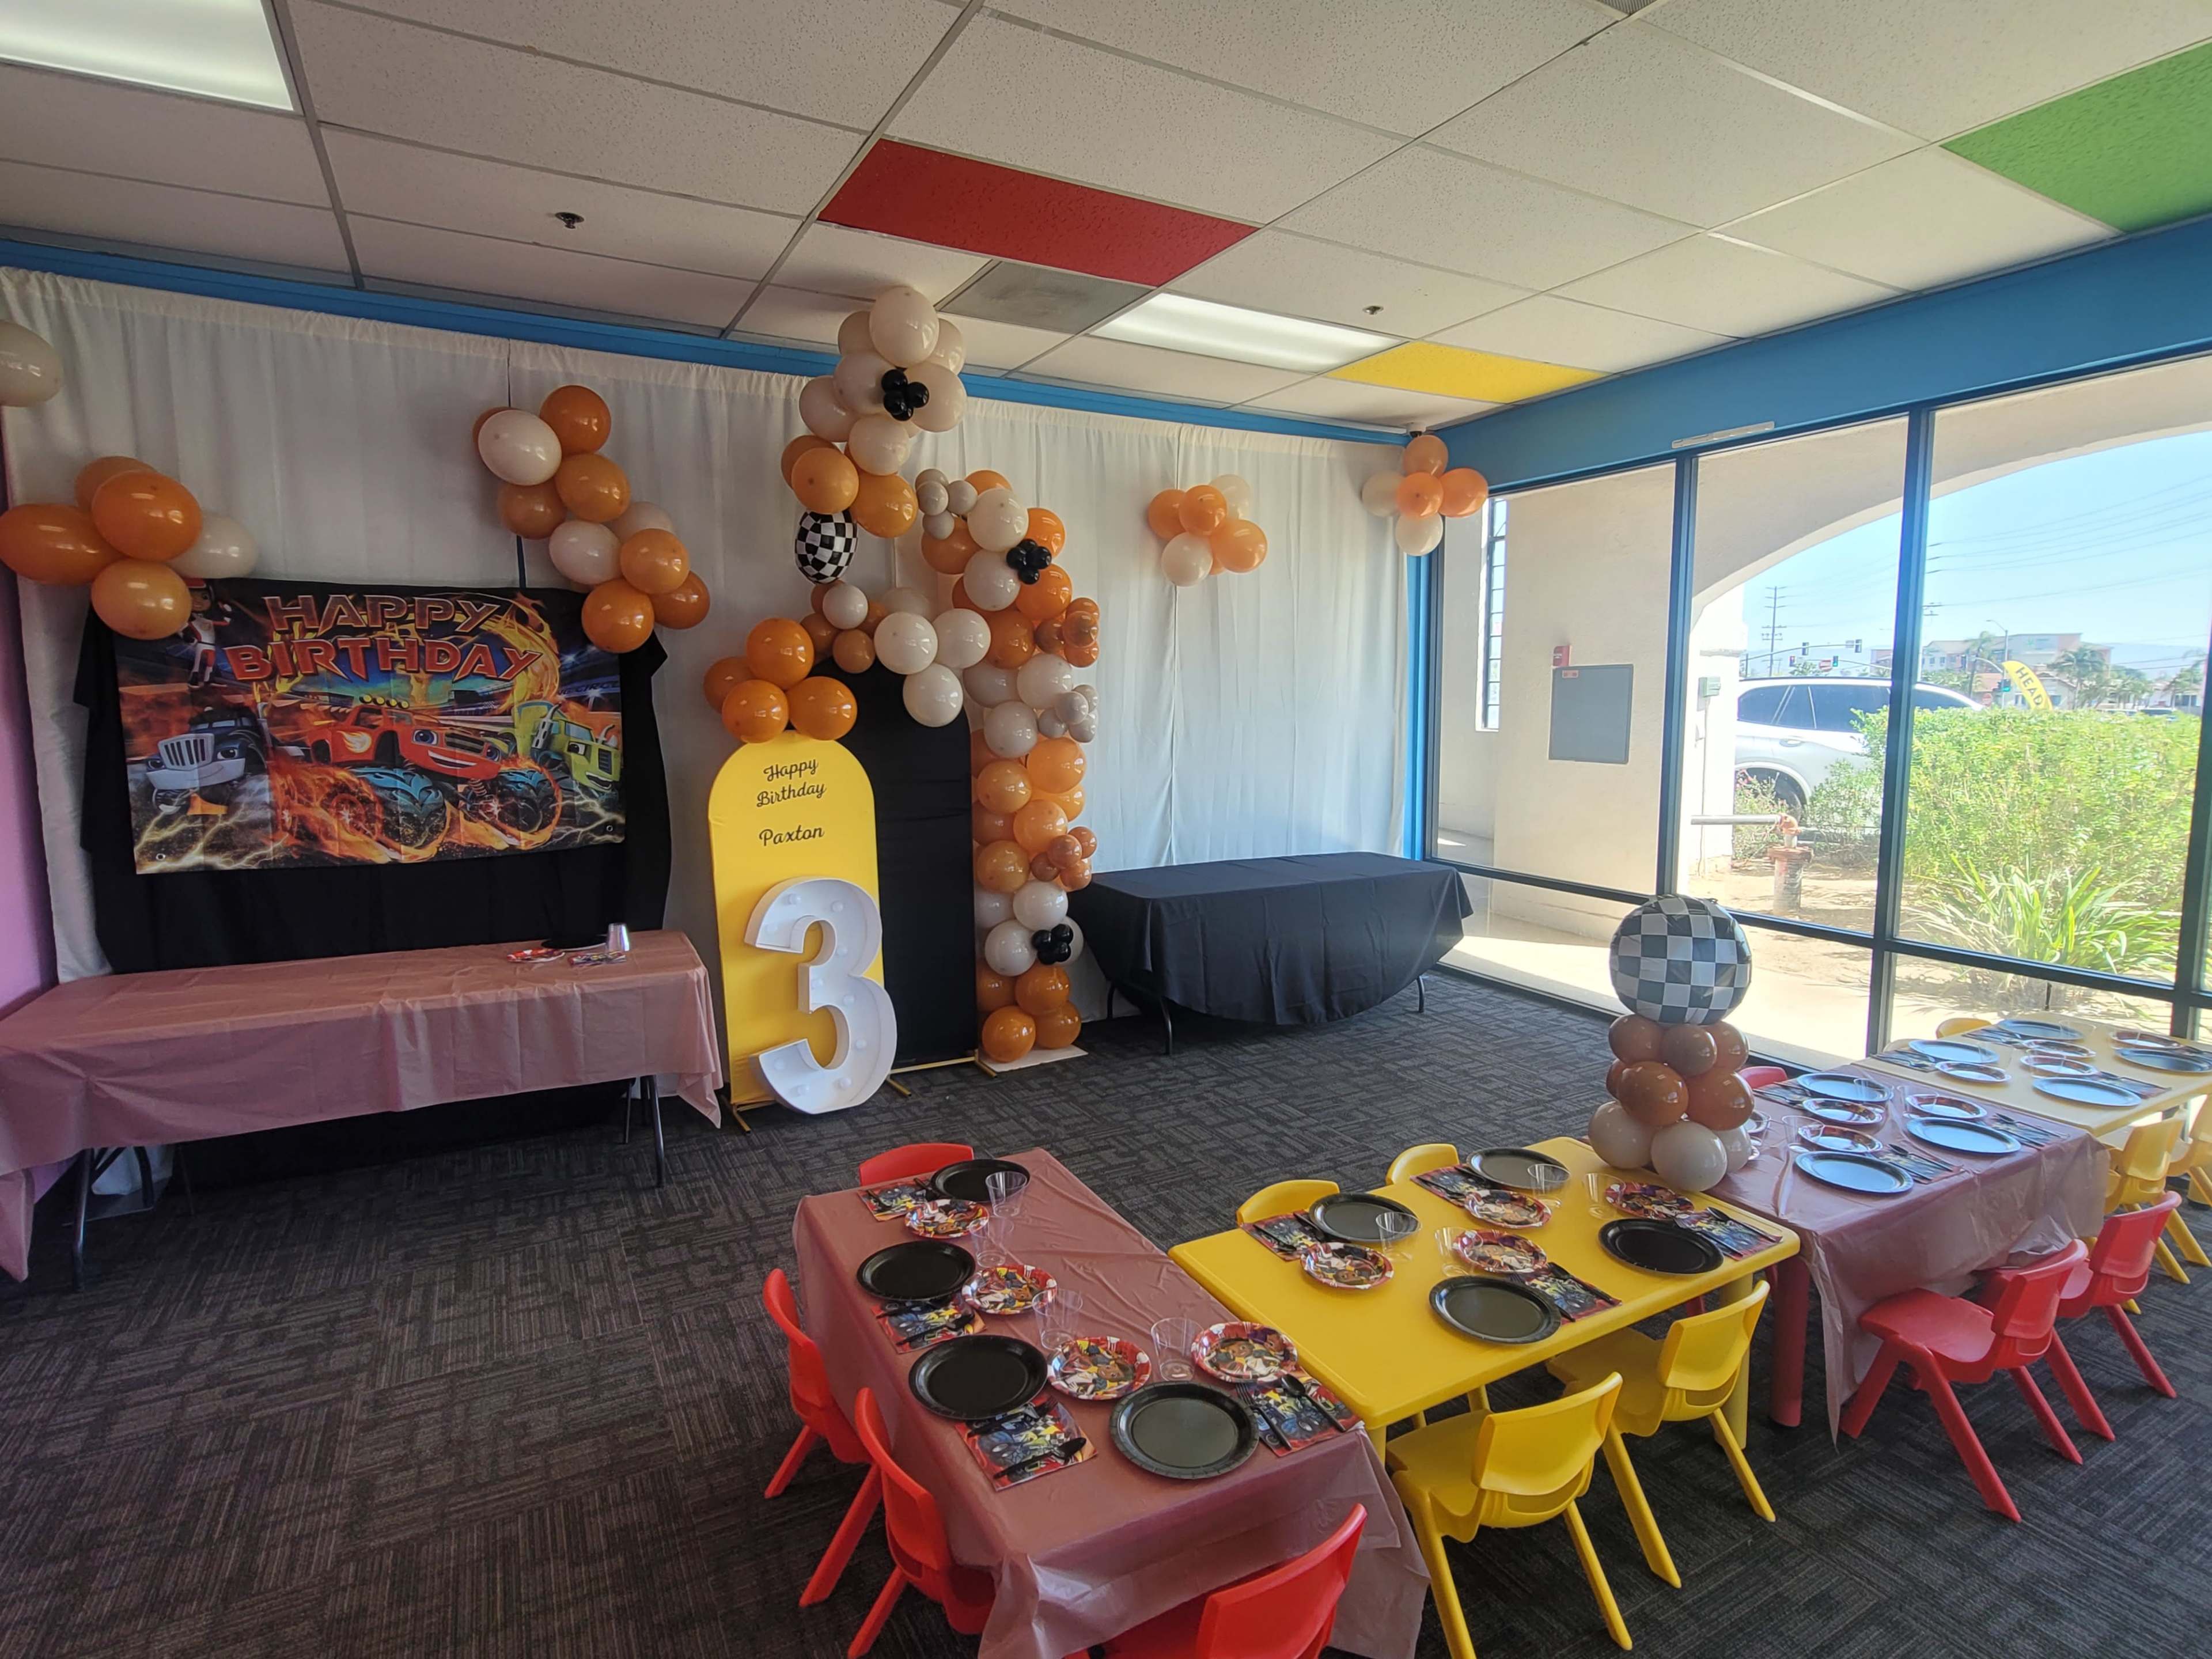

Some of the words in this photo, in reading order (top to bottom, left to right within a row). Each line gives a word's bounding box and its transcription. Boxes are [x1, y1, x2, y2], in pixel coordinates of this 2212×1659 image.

[263, 594, 501, 635] HAPPY
[222, 637, 543, 684] BIRTHDAY
[2016, 666, 2044, 706] HEAD
[763, 759, 819, 782] Happy
[756, 781, 827, 808] Birthday
[759, 824, 825, 847] Paxton
[744, 876, 897, 1115] 3
